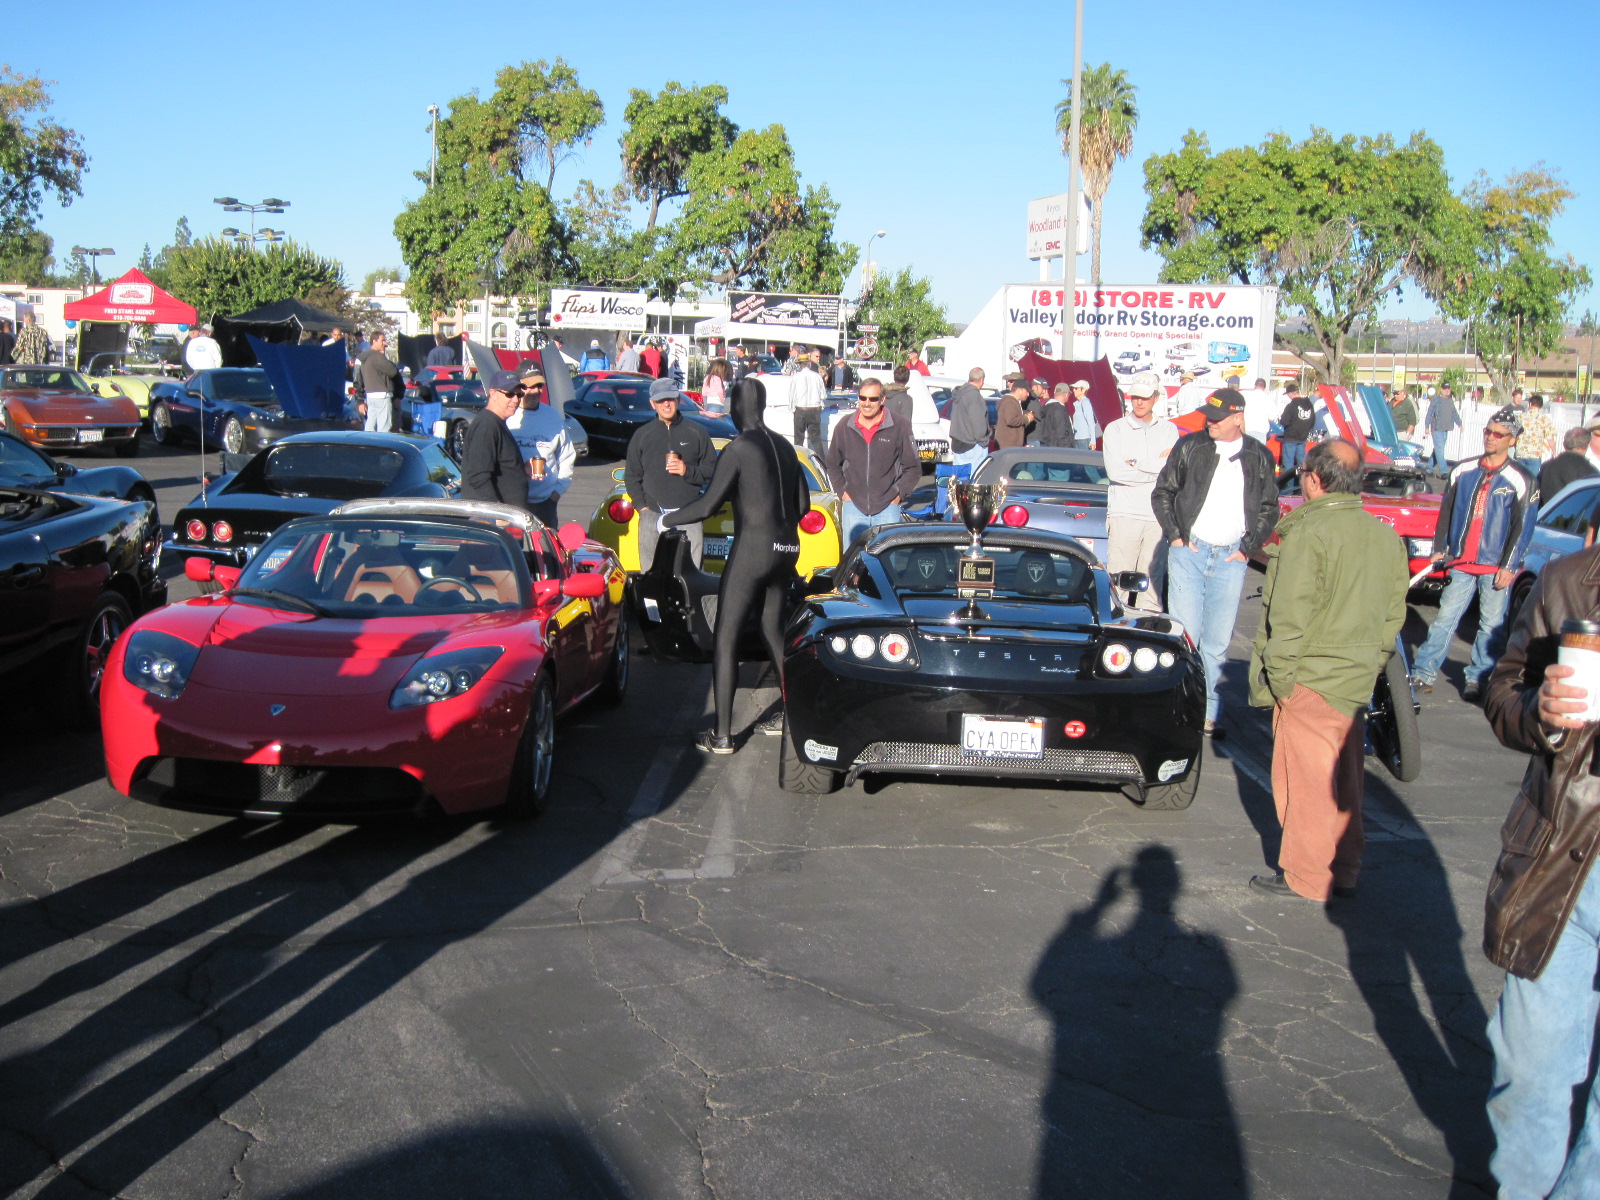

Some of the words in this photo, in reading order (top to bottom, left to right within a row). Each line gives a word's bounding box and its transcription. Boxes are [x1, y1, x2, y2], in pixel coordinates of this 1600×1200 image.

[1029, 217, 1061, 233] Woodland
[1046, 241, 1060, 250] GMC
[561, 294, 598, 318] Flip's
[601, 297, 643, 315] Wesco
[1093, 291, 1174, 308] STORE
[1130, 331, 1163, 340] Opening
[953, 649, 1062, 661] TESLA
